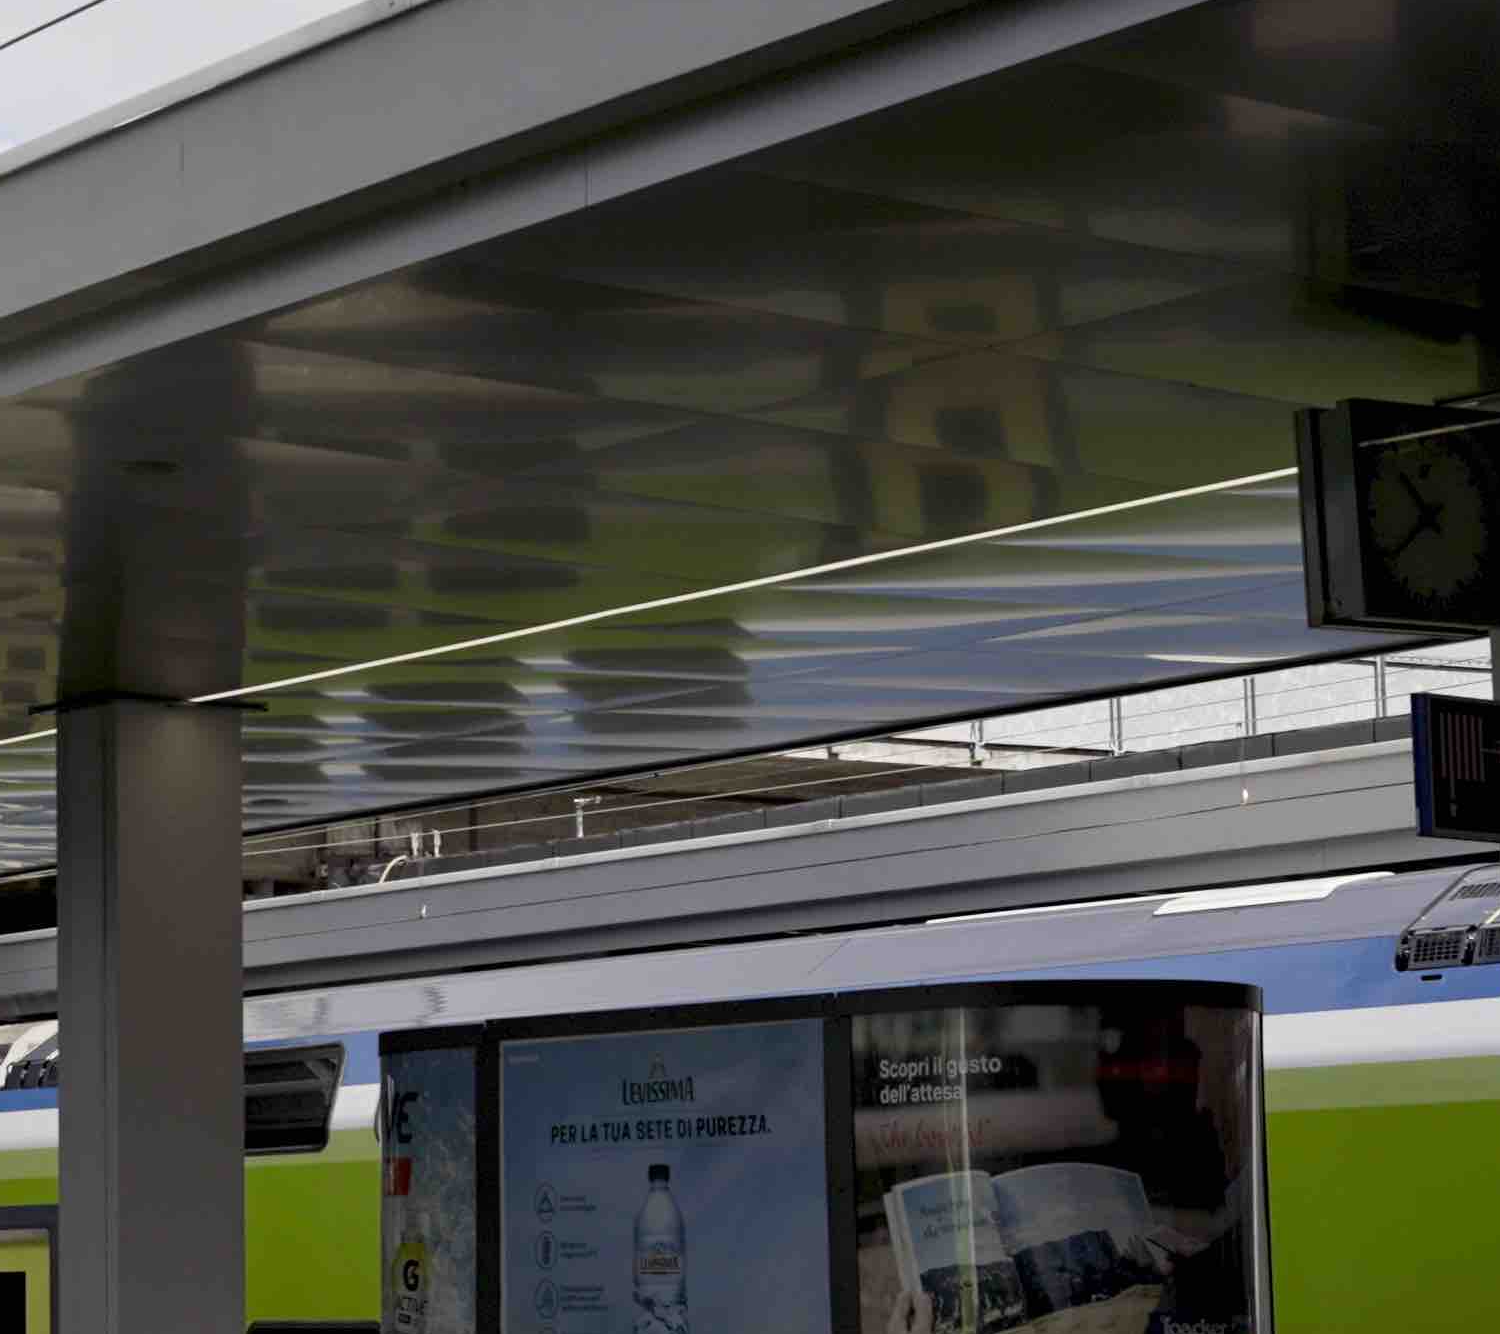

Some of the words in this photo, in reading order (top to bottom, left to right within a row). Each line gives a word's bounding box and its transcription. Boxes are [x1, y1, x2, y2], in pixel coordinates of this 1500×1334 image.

[879, 1056, 930, 1081] Scopri
[932, 1056, 943, 1075] il
[946, 1056, 1003, 1078] gusto
[622, 1077, 696, 1105] LEVISSIMA
[879, 1083, 967, 1105] dell'attesa
[551, 1123, 577, 1144] PER
[581, 1122, 599, 1143] LA
[600, 1121, 631, 1142] TUA
[636, 1120, 673, 1140] SETE
[678, 1119, 693, 1139] DI
[696, 1114, 772, 1137] PUREZZA.
